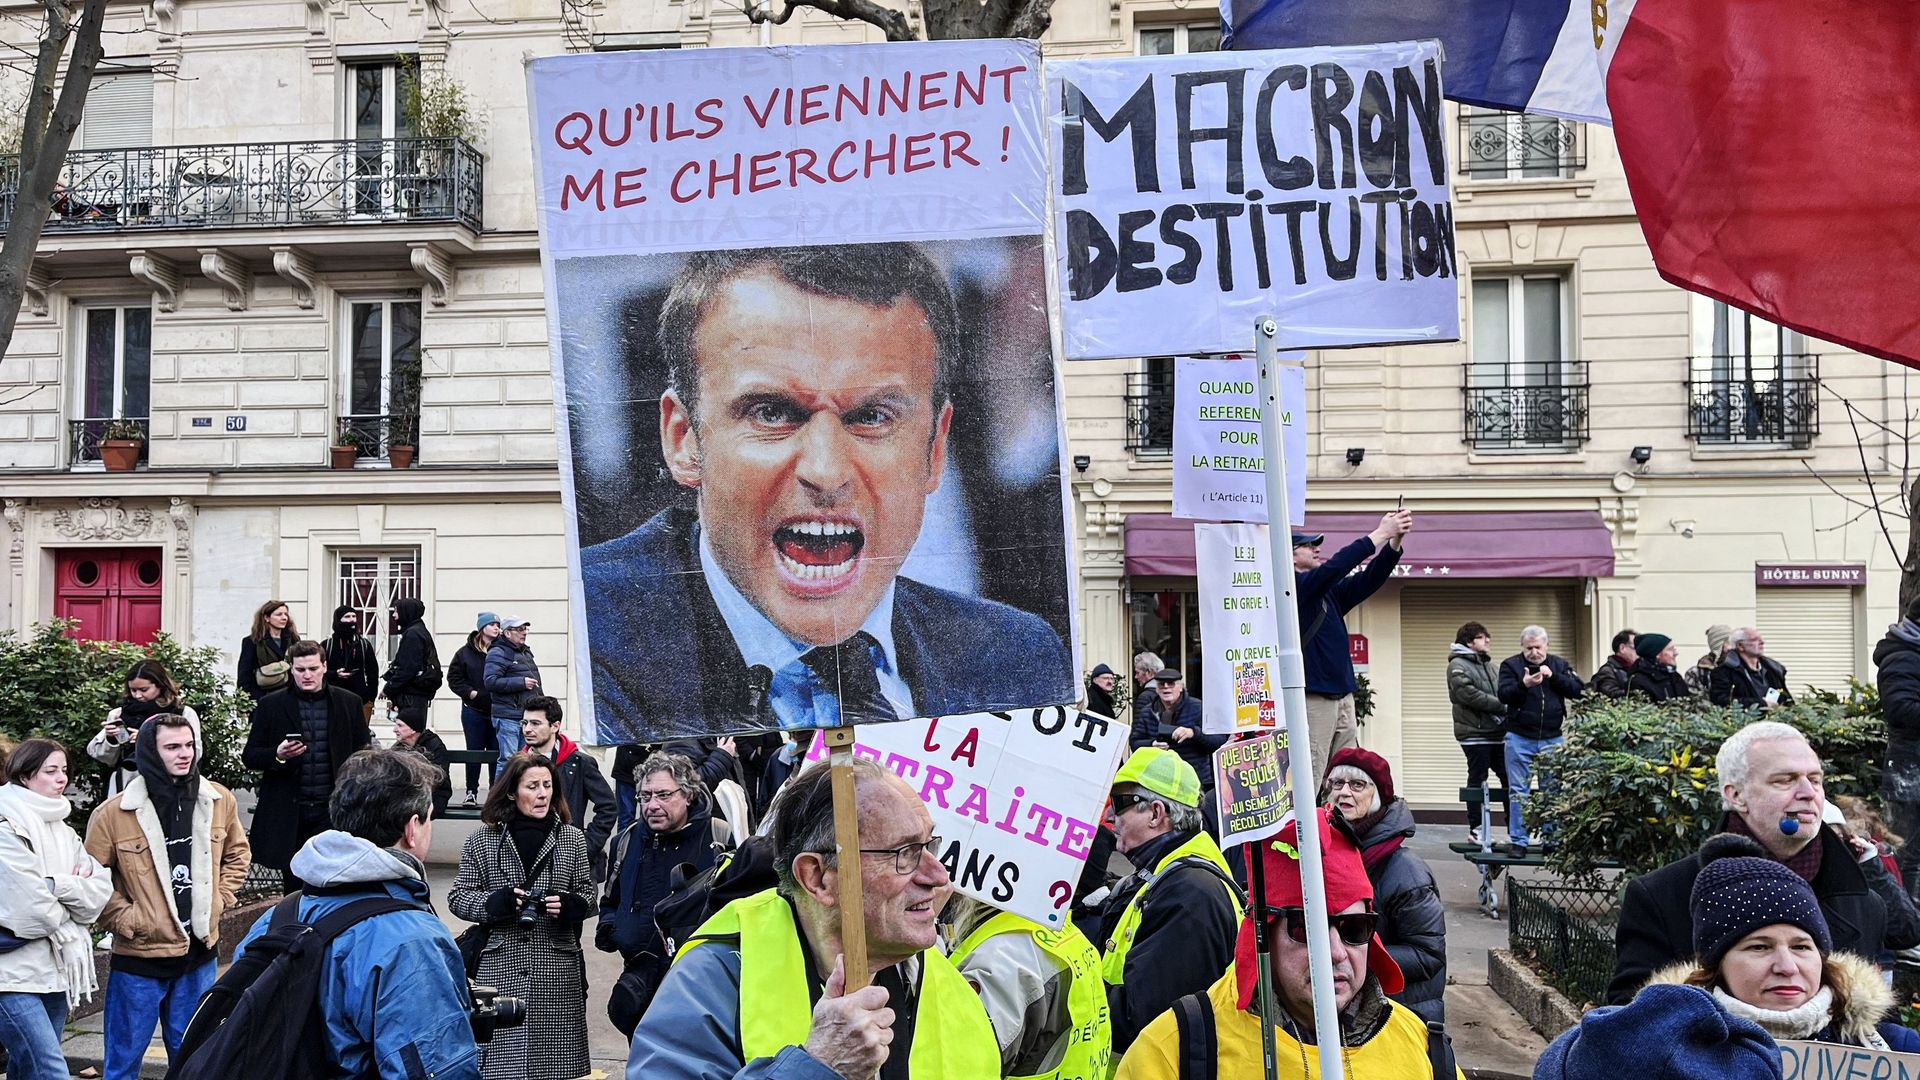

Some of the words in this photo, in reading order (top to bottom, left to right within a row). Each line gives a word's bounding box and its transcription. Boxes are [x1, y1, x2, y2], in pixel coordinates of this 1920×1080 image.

[554, 98, 723, 155] QU'ILS
[743, 63, 1027, 131] VIENNENT
[1061, 57, 1446, 196] MACRON
[560, 167, 648, 211] ME
[669, 128, 980, 204] CHERCHER
[1000, 125, 1011, 163] !
[1200, 382, 1254, 395] QUAND
[1200, 406, 1292, 423] REFERENM
[227, 416, 244, 430] 50
[1220, 431, 1259, 445] POUR
[1192, 455, 1209, 468] LA
[1210, 492, 1248, 503] L'Article
[1234, 546, 1245, 559] LE
[1246, 546, 1256, 559] 31
[1232, 571, 1262, 585] JANVIER
[1763, 567, 1810, 580] HÔTEL
[1813, 569, 1860, 580] SUNNY
[1223, 597, 1238, 610] EN
[1240, 596, 1262, 610] GREVE
[1240, 622, 1251, 635] OU
[1354, 639, 1364, 651] H
[1225, 649, 1241, 662] ON
[1243, 647, 1271, 660] CREVE
[1259, 707, 1276, 720] cgt
[1220, 748, 1241, 769] QUE
[1242, 743, 1260, 762] CE
[1230, 800, 1245, 815] QUI
[1230, 813, 1269, 832] RÉCOLTE
[1048, 880, 1072, 922] ?
